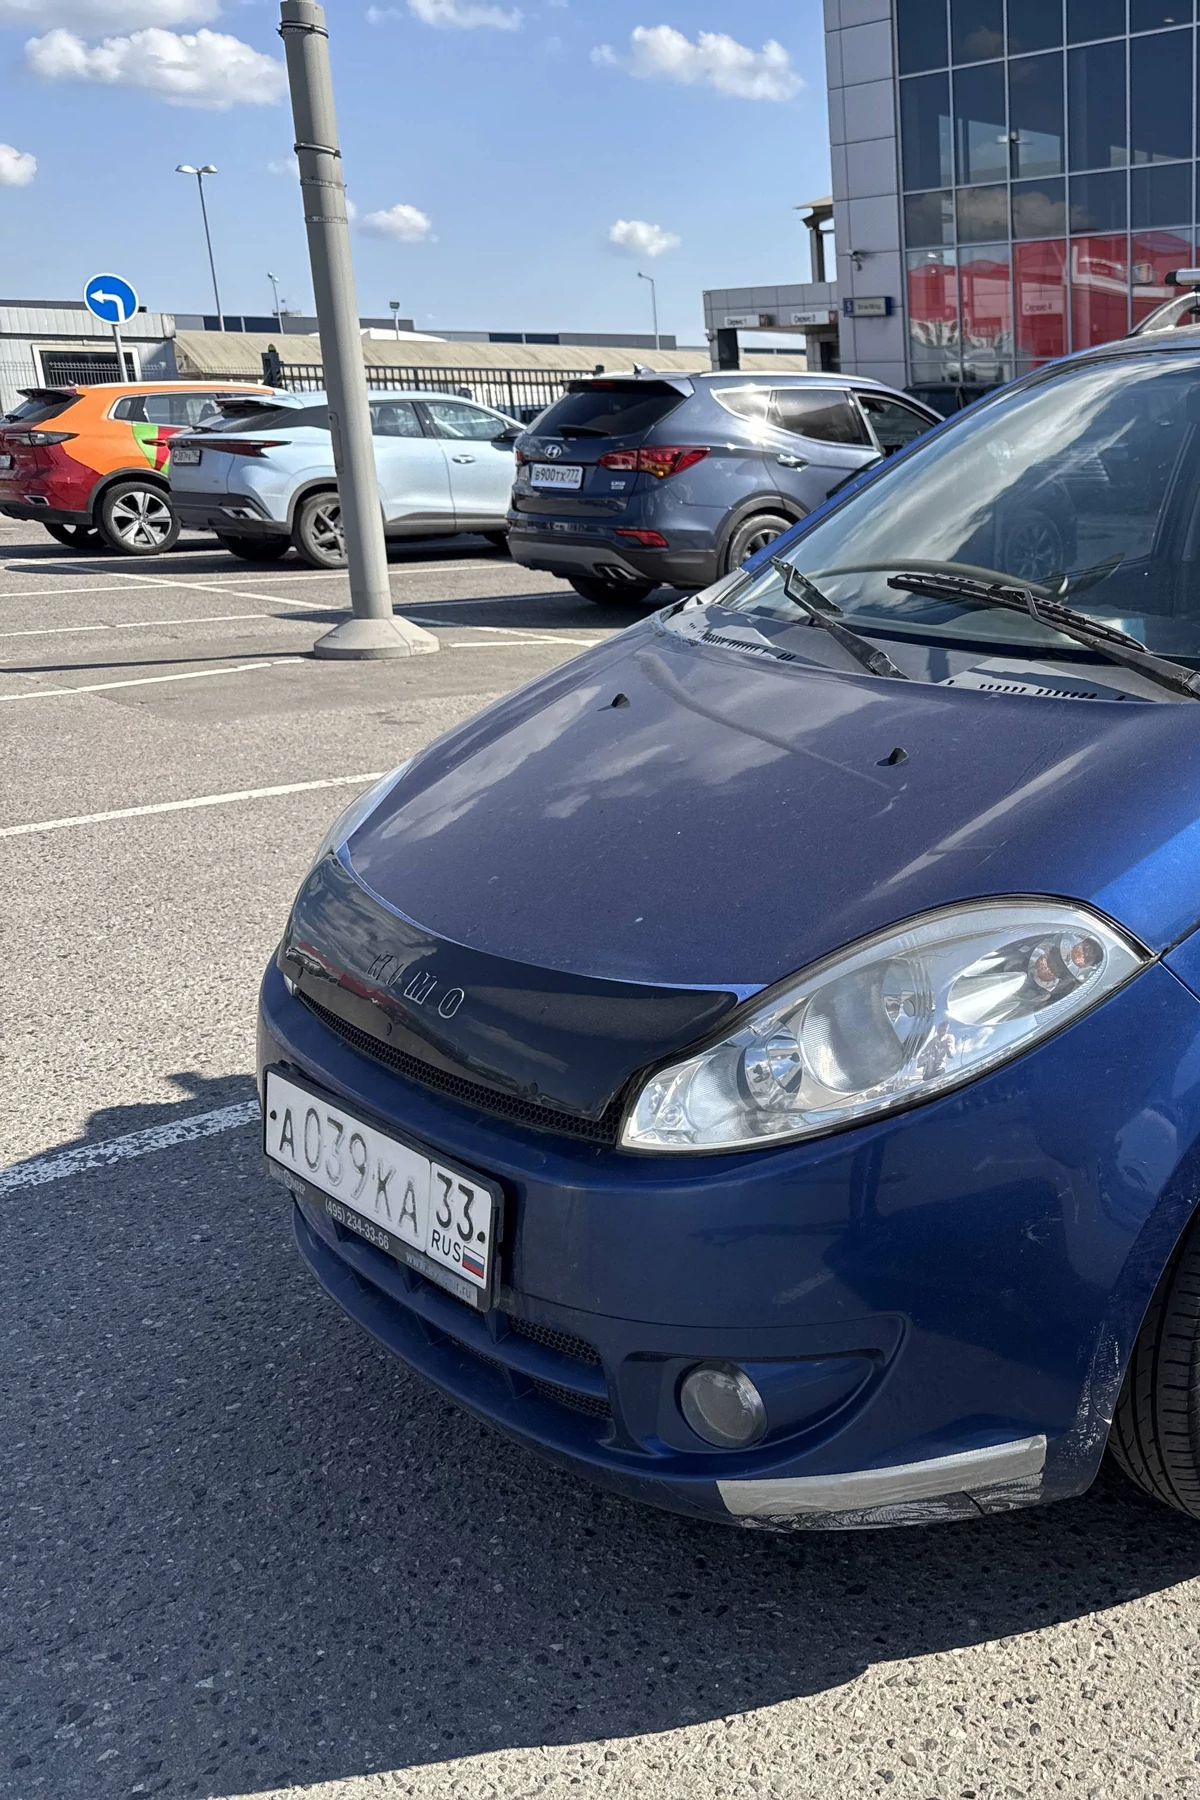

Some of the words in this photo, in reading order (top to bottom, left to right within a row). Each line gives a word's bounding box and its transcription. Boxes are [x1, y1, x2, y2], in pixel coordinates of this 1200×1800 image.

[325, 1197, 345, 1225] (495)
[346, 1213, 390, 1250] 234-33-66
[435, 1172, 474, 1243] 33
[431, 1229, 461, 1263] RUS
